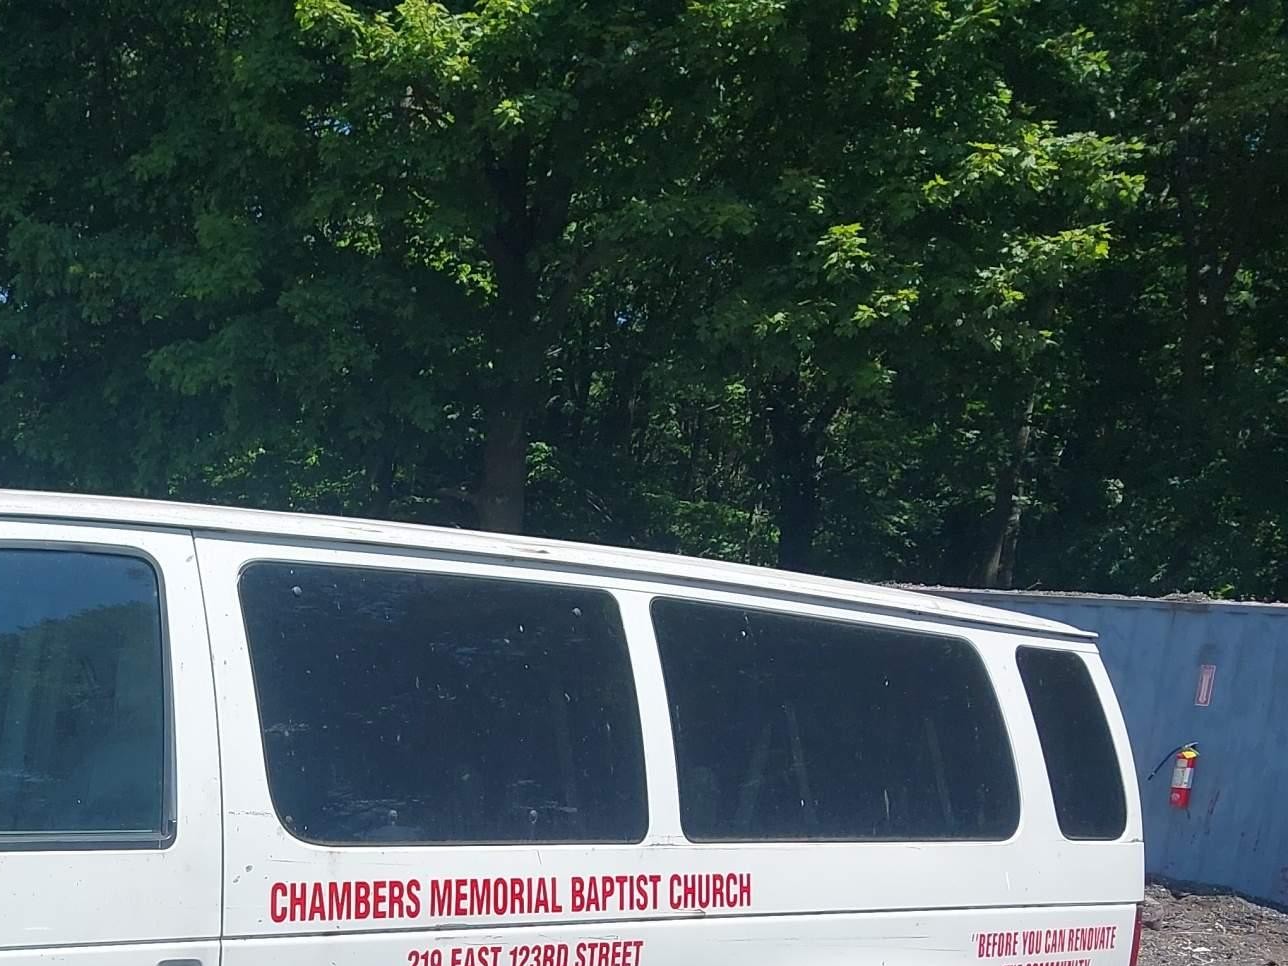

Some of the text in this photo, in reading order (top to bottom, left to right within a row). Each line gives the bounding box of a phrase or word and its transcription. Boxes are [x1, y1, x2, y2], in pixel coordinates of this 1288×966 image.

[269, 872, 752, 923] CHAMBERS MEMORIAL BAPTIST CHURCH
[1021, 931, 1042, 955] YOU
[1044, 928, 1065, 954] CAN
[1067, 926, 1117, 952] RENOVATE
